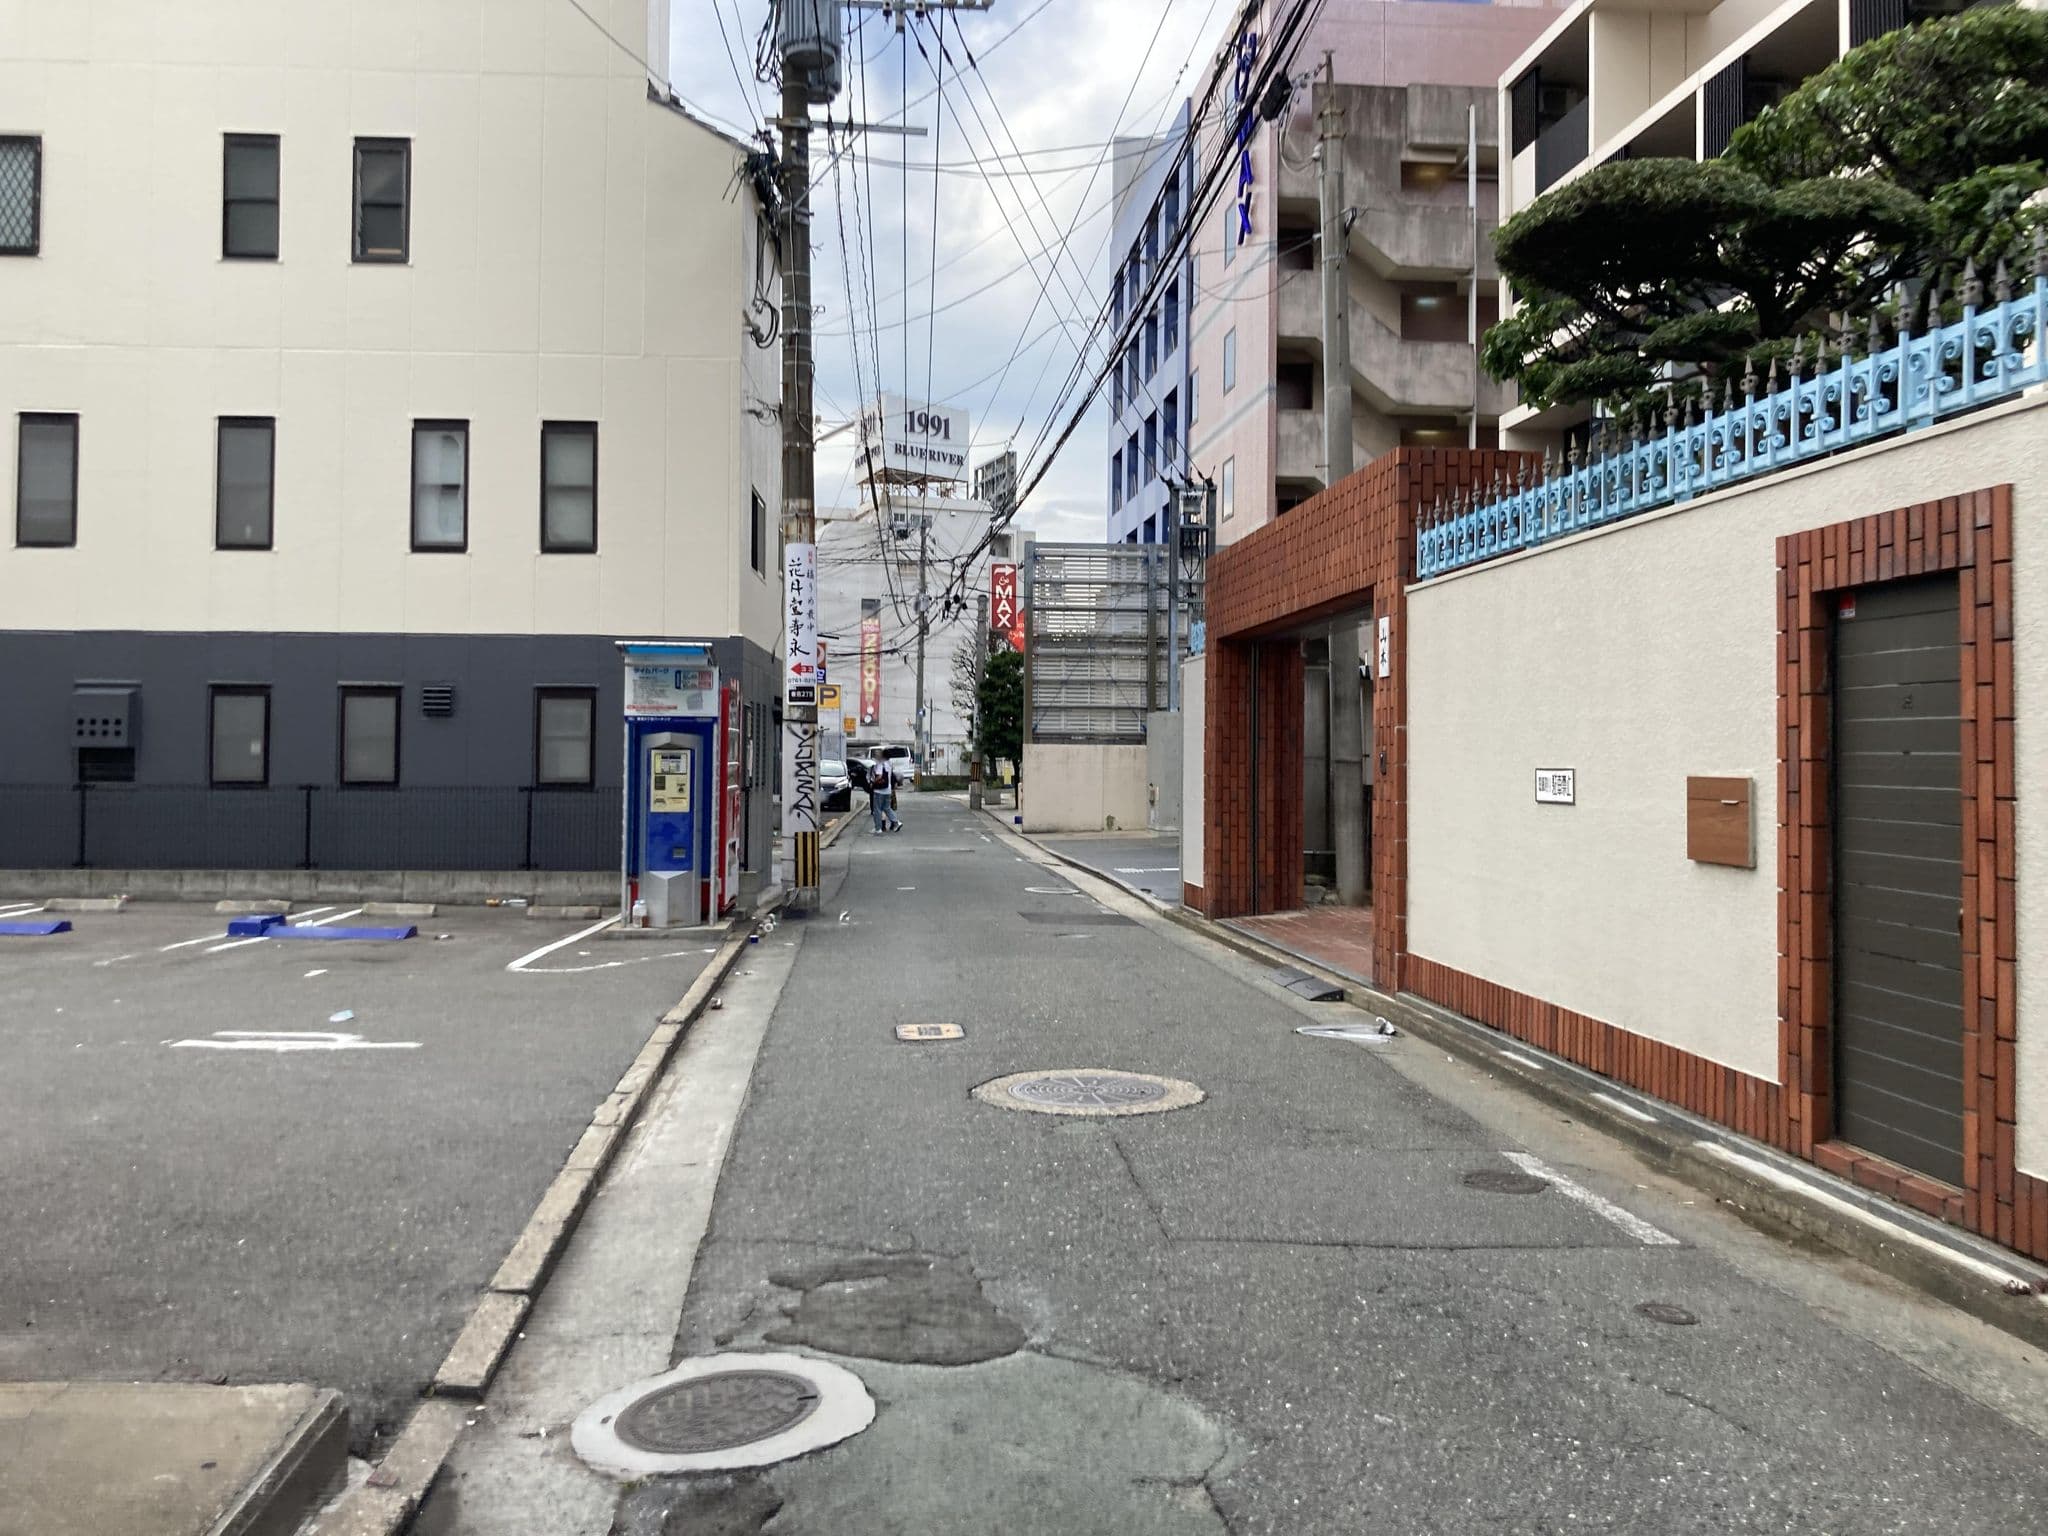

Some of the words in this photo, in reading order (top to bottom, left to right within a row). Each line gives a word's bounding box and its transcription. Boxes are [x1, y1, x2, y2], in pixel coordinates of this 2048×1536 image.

[908, 410, 950, 440] 1991
[995, 585, 1013, 628] MAX
[819, 687, 837, 706] P
